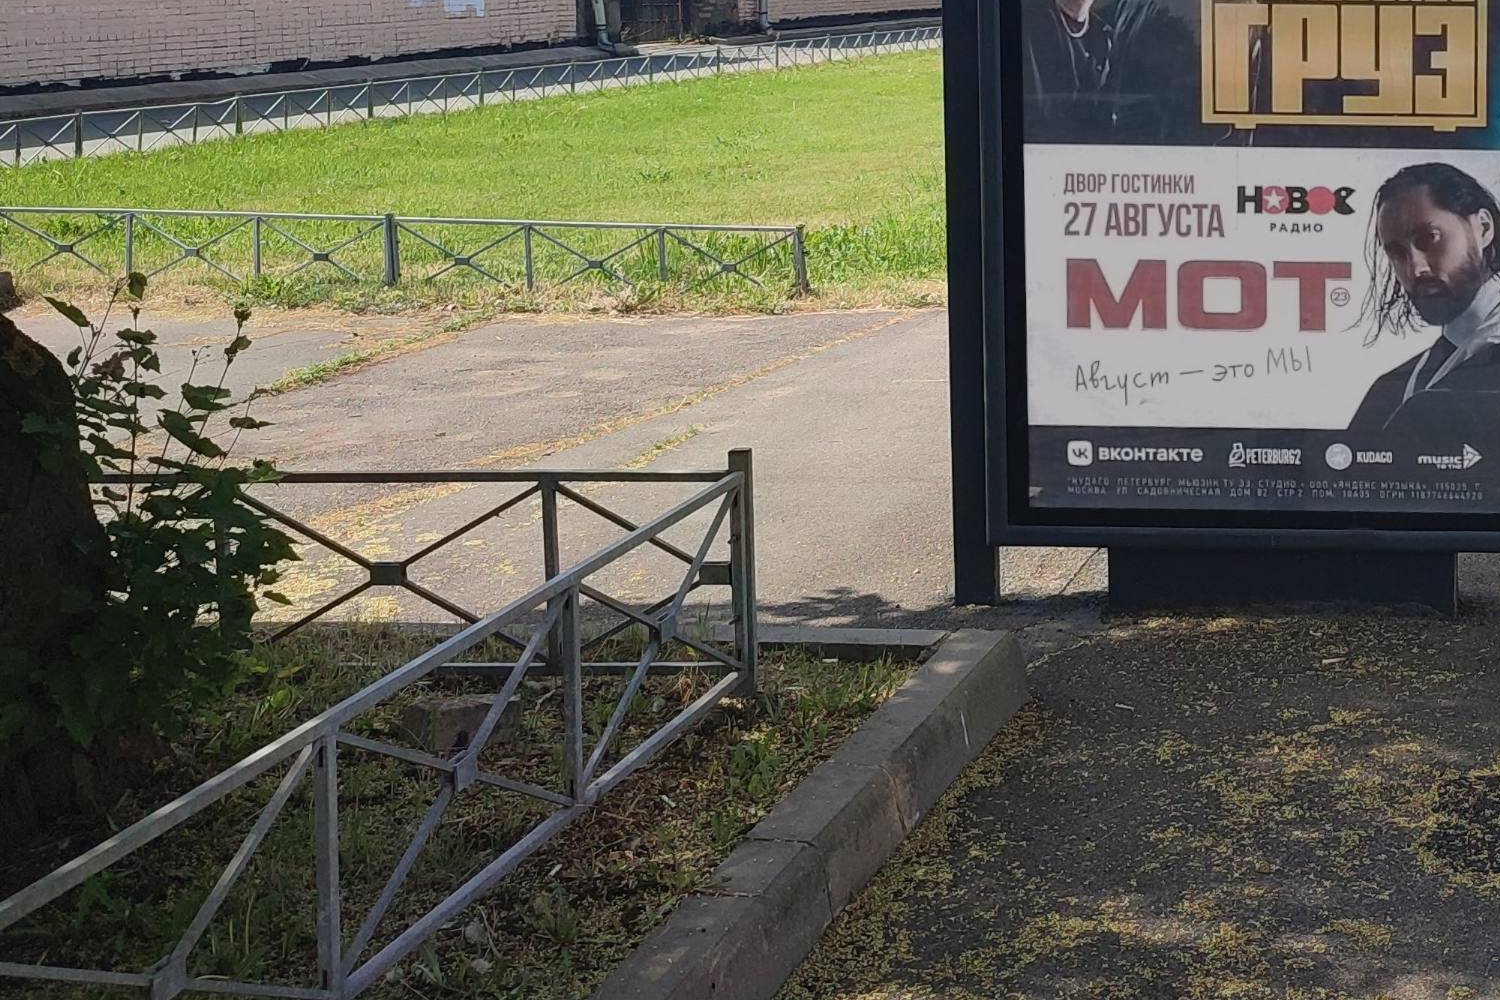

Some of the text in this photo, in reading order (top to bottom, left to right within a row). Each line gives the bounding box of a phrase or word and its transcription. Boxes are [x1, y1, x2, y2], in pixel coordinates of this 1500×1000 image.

[1214, 3, 1477, 116] ГРУЗ
[1063, 173, 1195, 195] ДВОР ГОСТИНКИ
[1064, 202, 1226, 238] 27 АВГУСТА
[1269, 222, 1324, 234] РАДИО
[1066, 258, 1352, 332] МОТ
[1074, 360, 1170, 406] Август
[1211, 363, 1255, 382] это
[1265, 345, 1313, 375] МЫ
